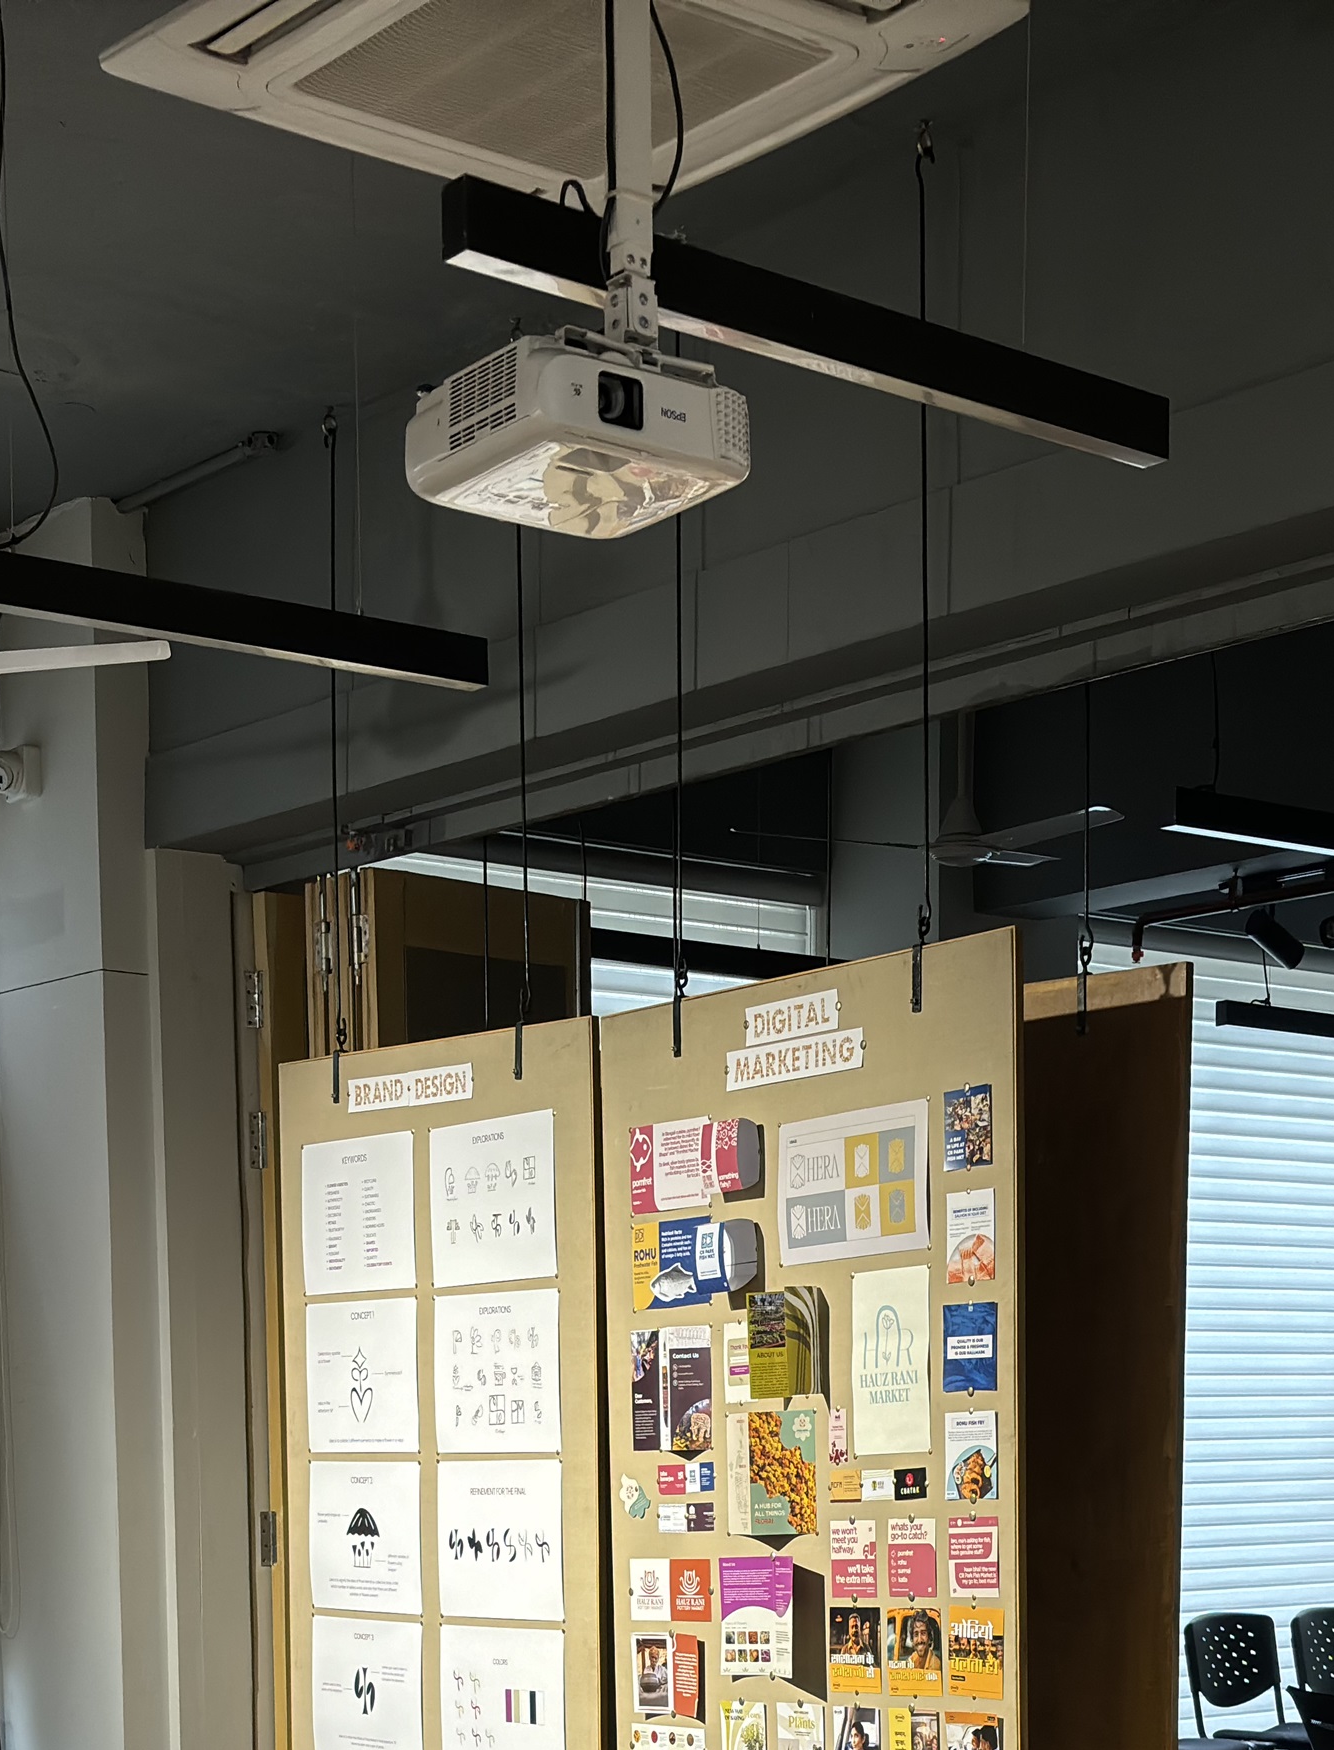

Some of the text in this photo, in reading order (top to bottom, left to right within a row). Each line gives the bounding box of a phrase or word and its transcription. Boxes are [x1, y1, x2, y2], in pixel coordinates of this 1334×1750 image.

[660, 407, 687, 423] EPSON
[354, 1079, 404, 1106] BRAND
[472, 1132, 504, 1144] EXPLORATIONS
[341, 1154, 368, 1165] KEYWORDS
[807, 1154, 840, 1182] HERA
[807, 1204, 841, 1233] HERA
[634, 1248, 657, 1262] ROHU
[479, 1306, 511, 1315] EXPLORATIONS
[860, 1370, 919, 1389] HAUZ RANI
[869, 1388, 911, 1405] MARKET
[890, 1523, 923, 1532] whats your
[846, 1537, 858, 1545] you
[788, 1715, 816, 1730] Plants
